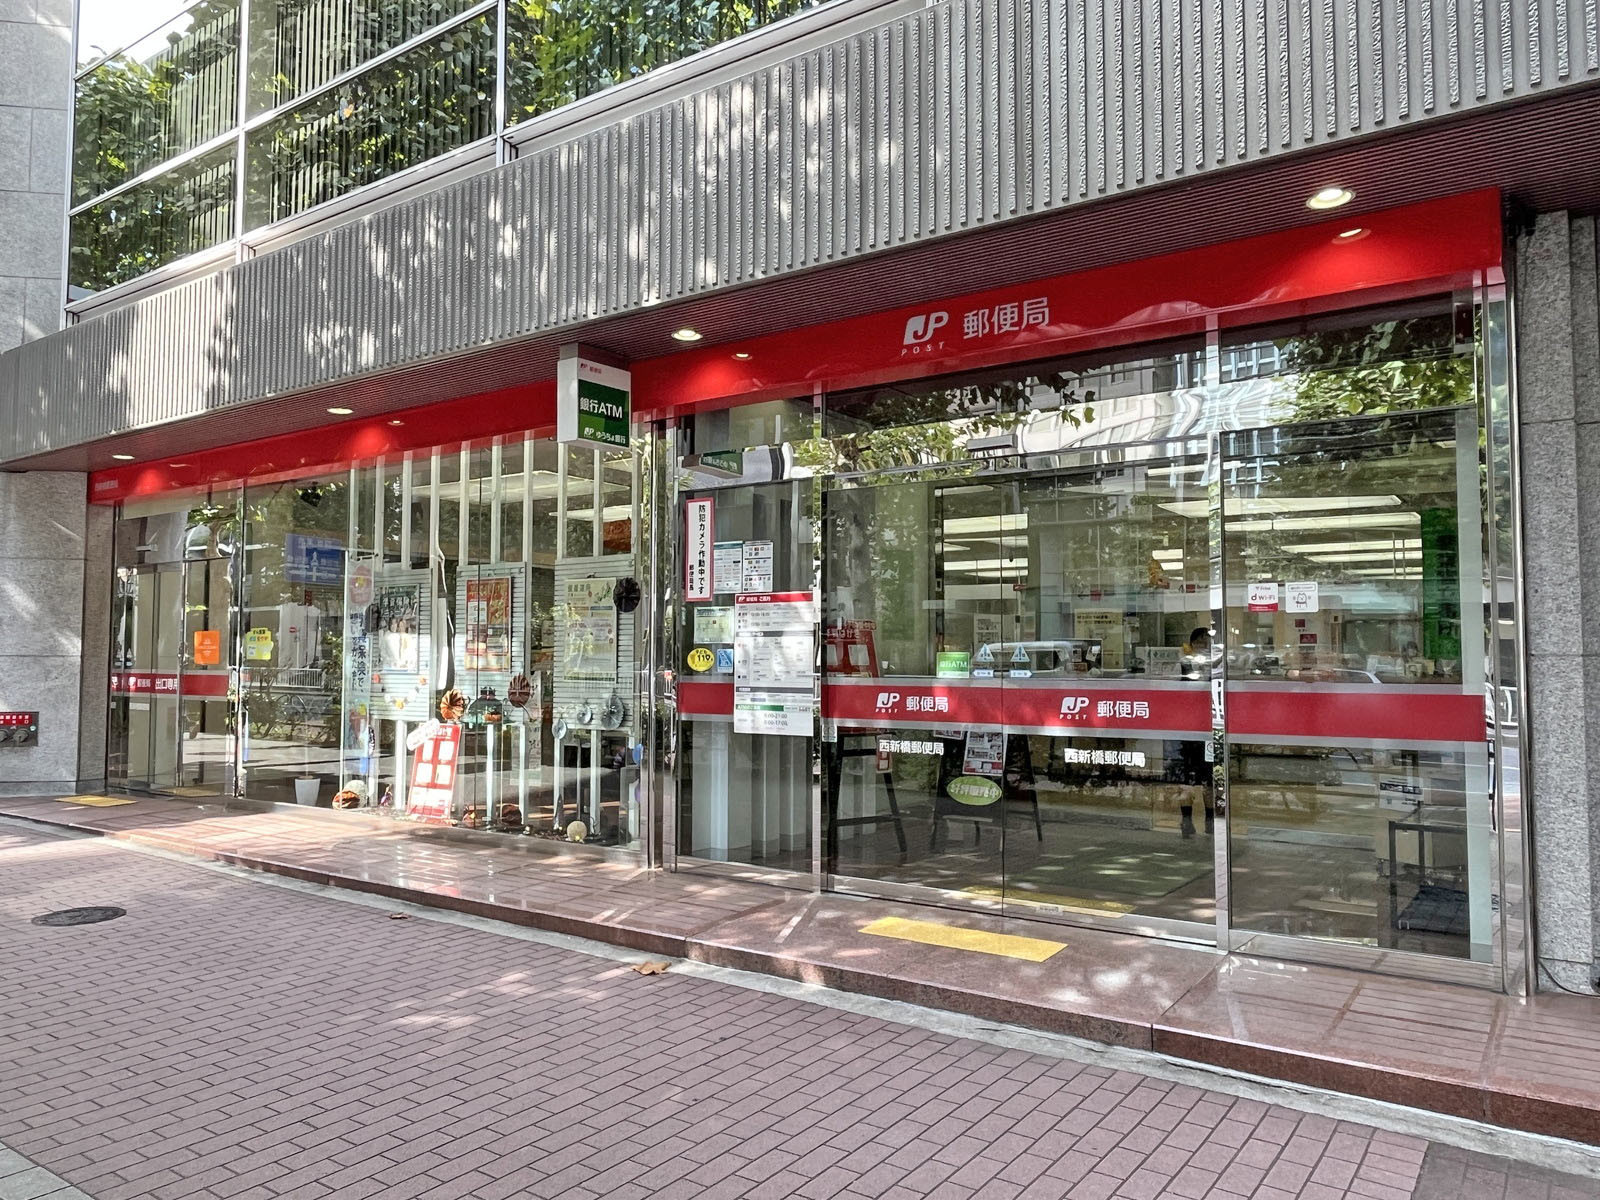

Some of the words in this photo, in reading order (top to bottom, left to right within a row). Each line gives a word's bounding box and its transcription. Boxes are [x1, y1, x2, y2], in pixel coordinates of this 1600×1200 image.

[963, 297, 1050, 339] 郵便局
[901, 342, 945, 356] POST
[580, 397, 623, 418] 銀行ATM
[596, 431, 626, 444] ゆうちょ銀行
[698, 504, 706, 594] 防犯カメラ作動中です
[906, 696, 949, 712] 郵便局
[1097, 701, 1150, 718] 郵便局
[879, 739, 944, 756] 西新橋郵便局
[1064, 748, 1146, 767] 西新橋郵便局
